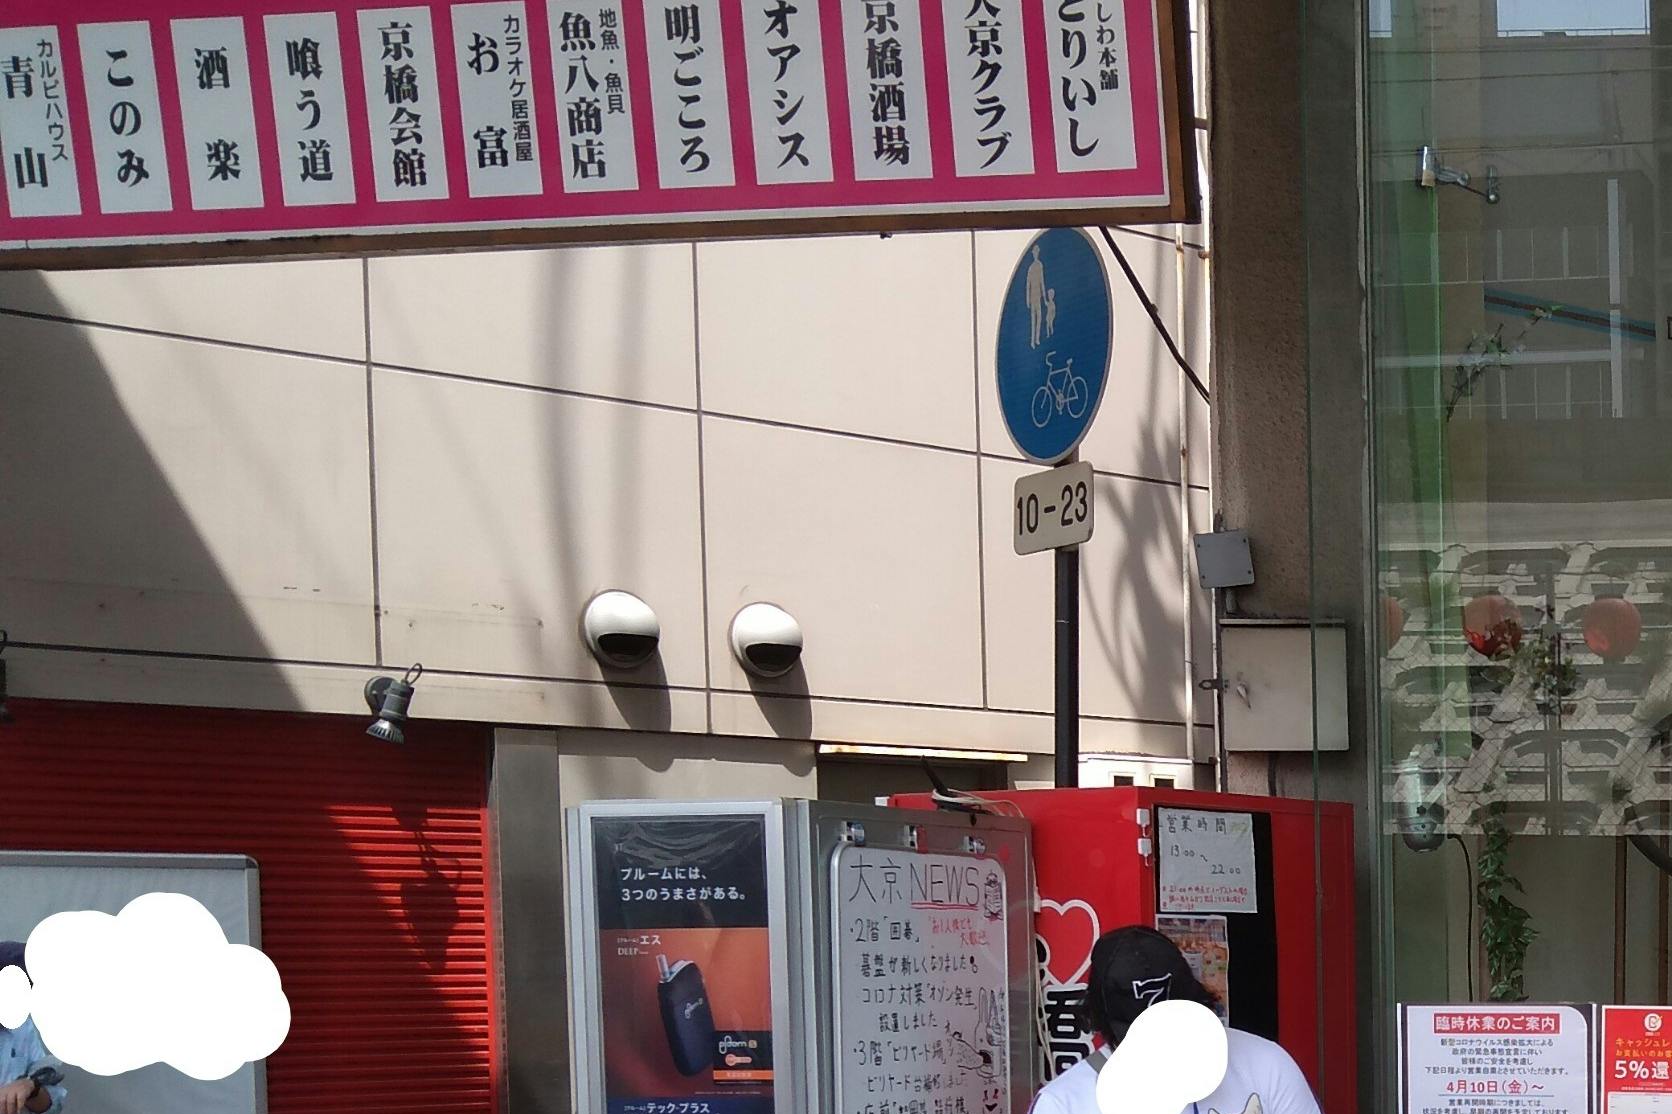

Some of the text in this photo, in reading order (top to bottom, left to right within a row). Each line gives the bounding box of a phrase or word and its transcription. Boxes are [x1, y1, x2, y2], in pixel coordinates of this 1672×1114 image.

[2, 56, 48, 189] 青山
[36, 39, 68, 161] カルビハウス
[105, 49, 150, 187] このみ
[194, 47, 242, 182] 酒楽
[286, 38, 334, 183] 喰う道
[377, 21, 428, 188] 京橋会館
[467, 32, 509, 169] お富
[503, 14, 534, 163] カラオケ居酒屋
[558, 12, 607, 180] 魚八商店
[664, 4, 711, 174] 明ごころ
[763, 0, 810, 169] オアシス
[864, 0, 910, 166] 京橋酒場
[1016, 480, 1088, 537] 10-23
[849, 854, 980, 906] 大京 NEWS
[1167, 813, 1228, 834] 営業時間
[622, 886, 746, 901] 3つのうまさがある。
[1133, 973, 1172, 1008] 7
[1436, 1016, 1555, 1032] 臨時休業のご案内
